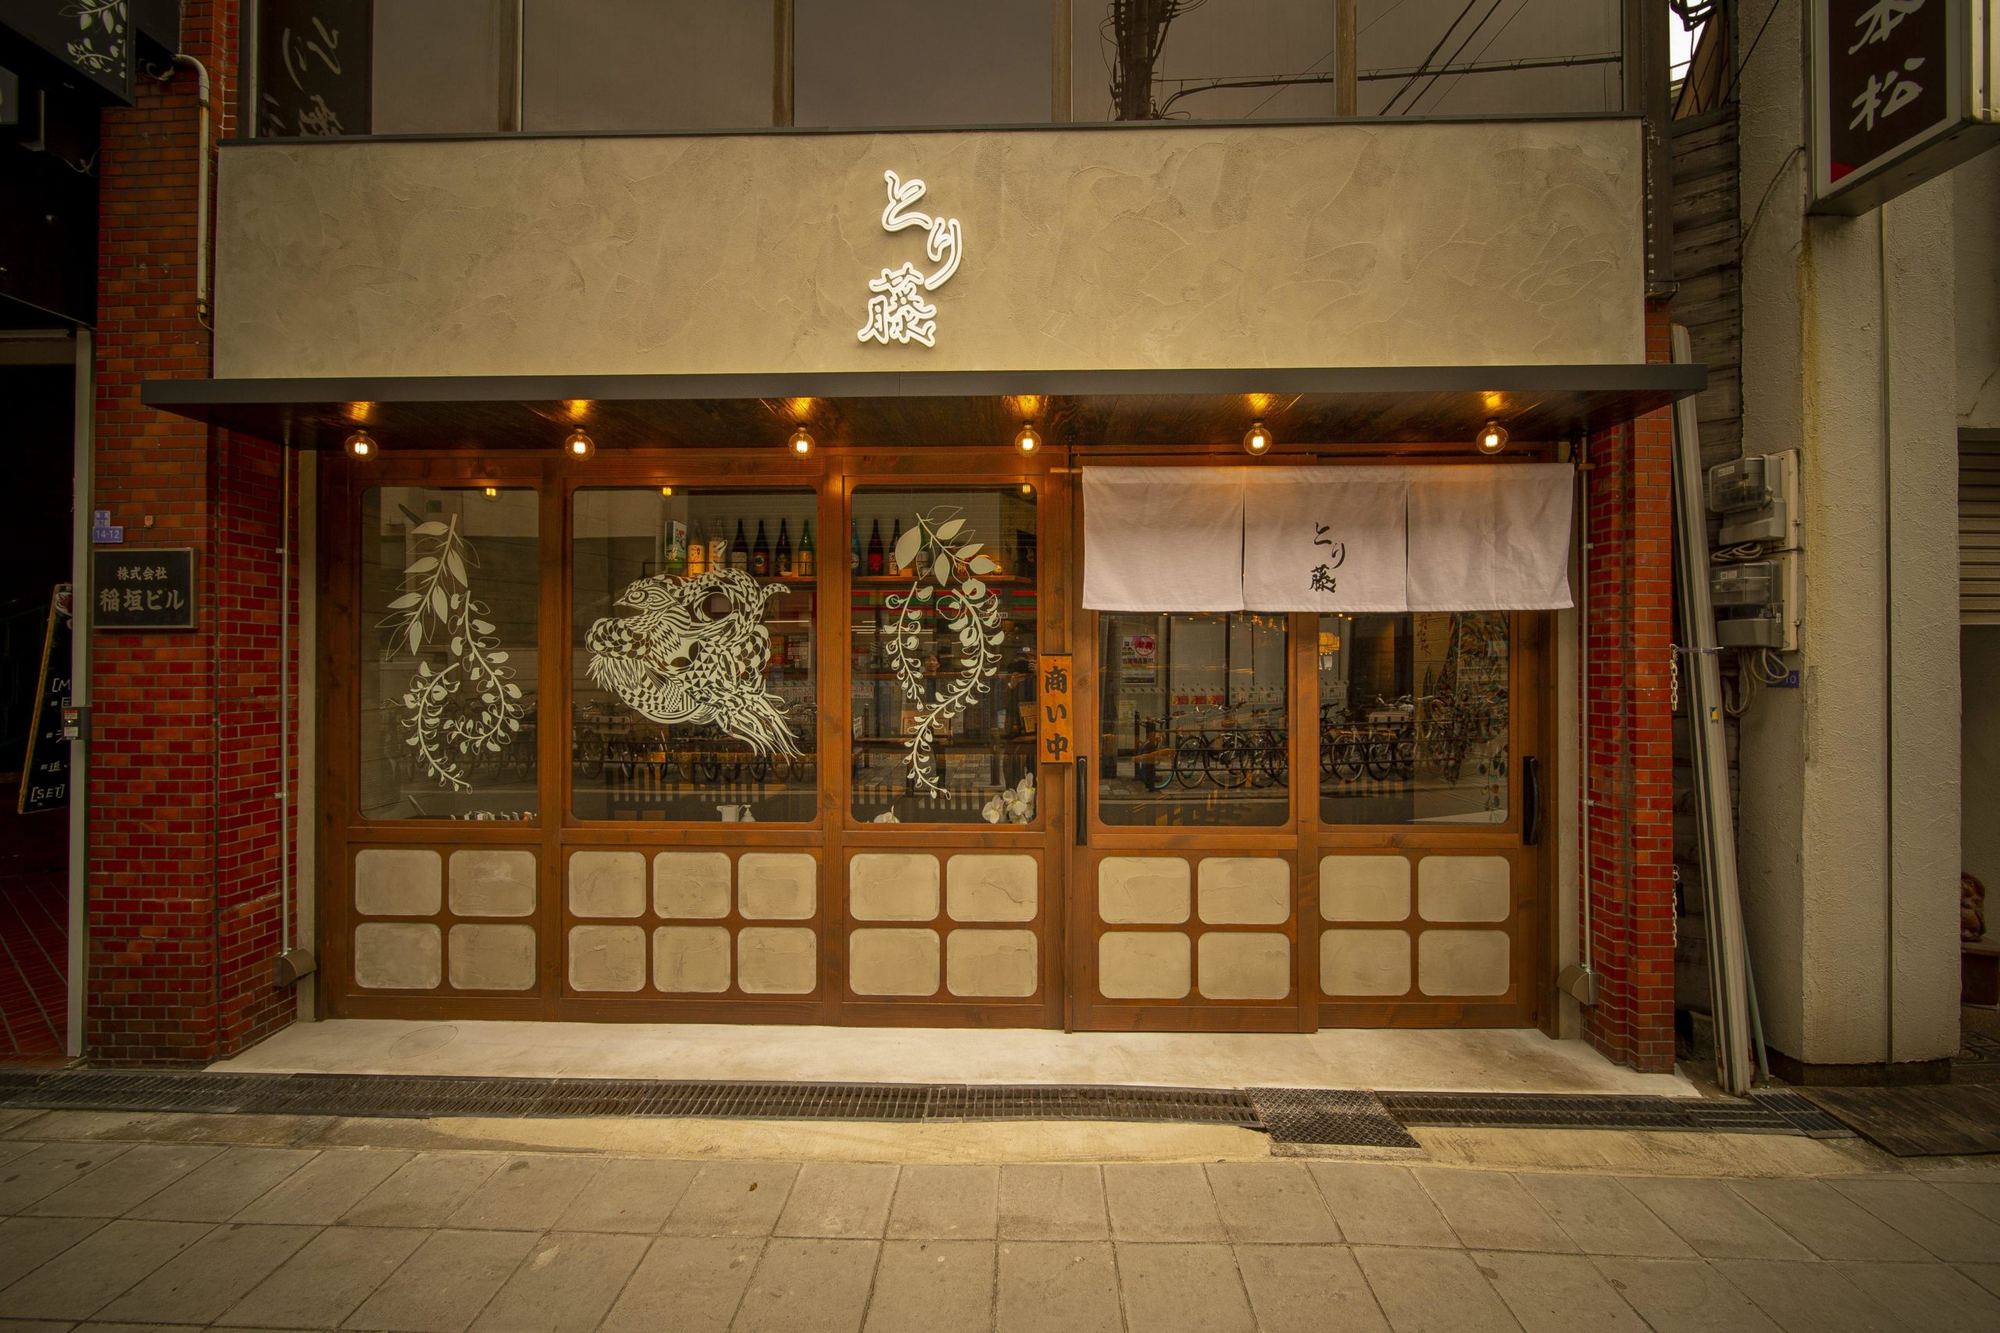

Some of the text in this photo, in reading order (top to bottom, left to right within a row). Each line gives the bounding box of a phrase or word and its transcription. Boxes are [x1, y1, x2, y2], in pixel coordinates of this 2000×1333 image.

[857, 169, 962, 347] とり藤
[116, 566, 168, 581] 株式会社
[1309, 521, 1345, 593] とり藤
[99, 587, 185, 612] 稲垣ビル
[1044, 665, 1069, 761] 商い中
